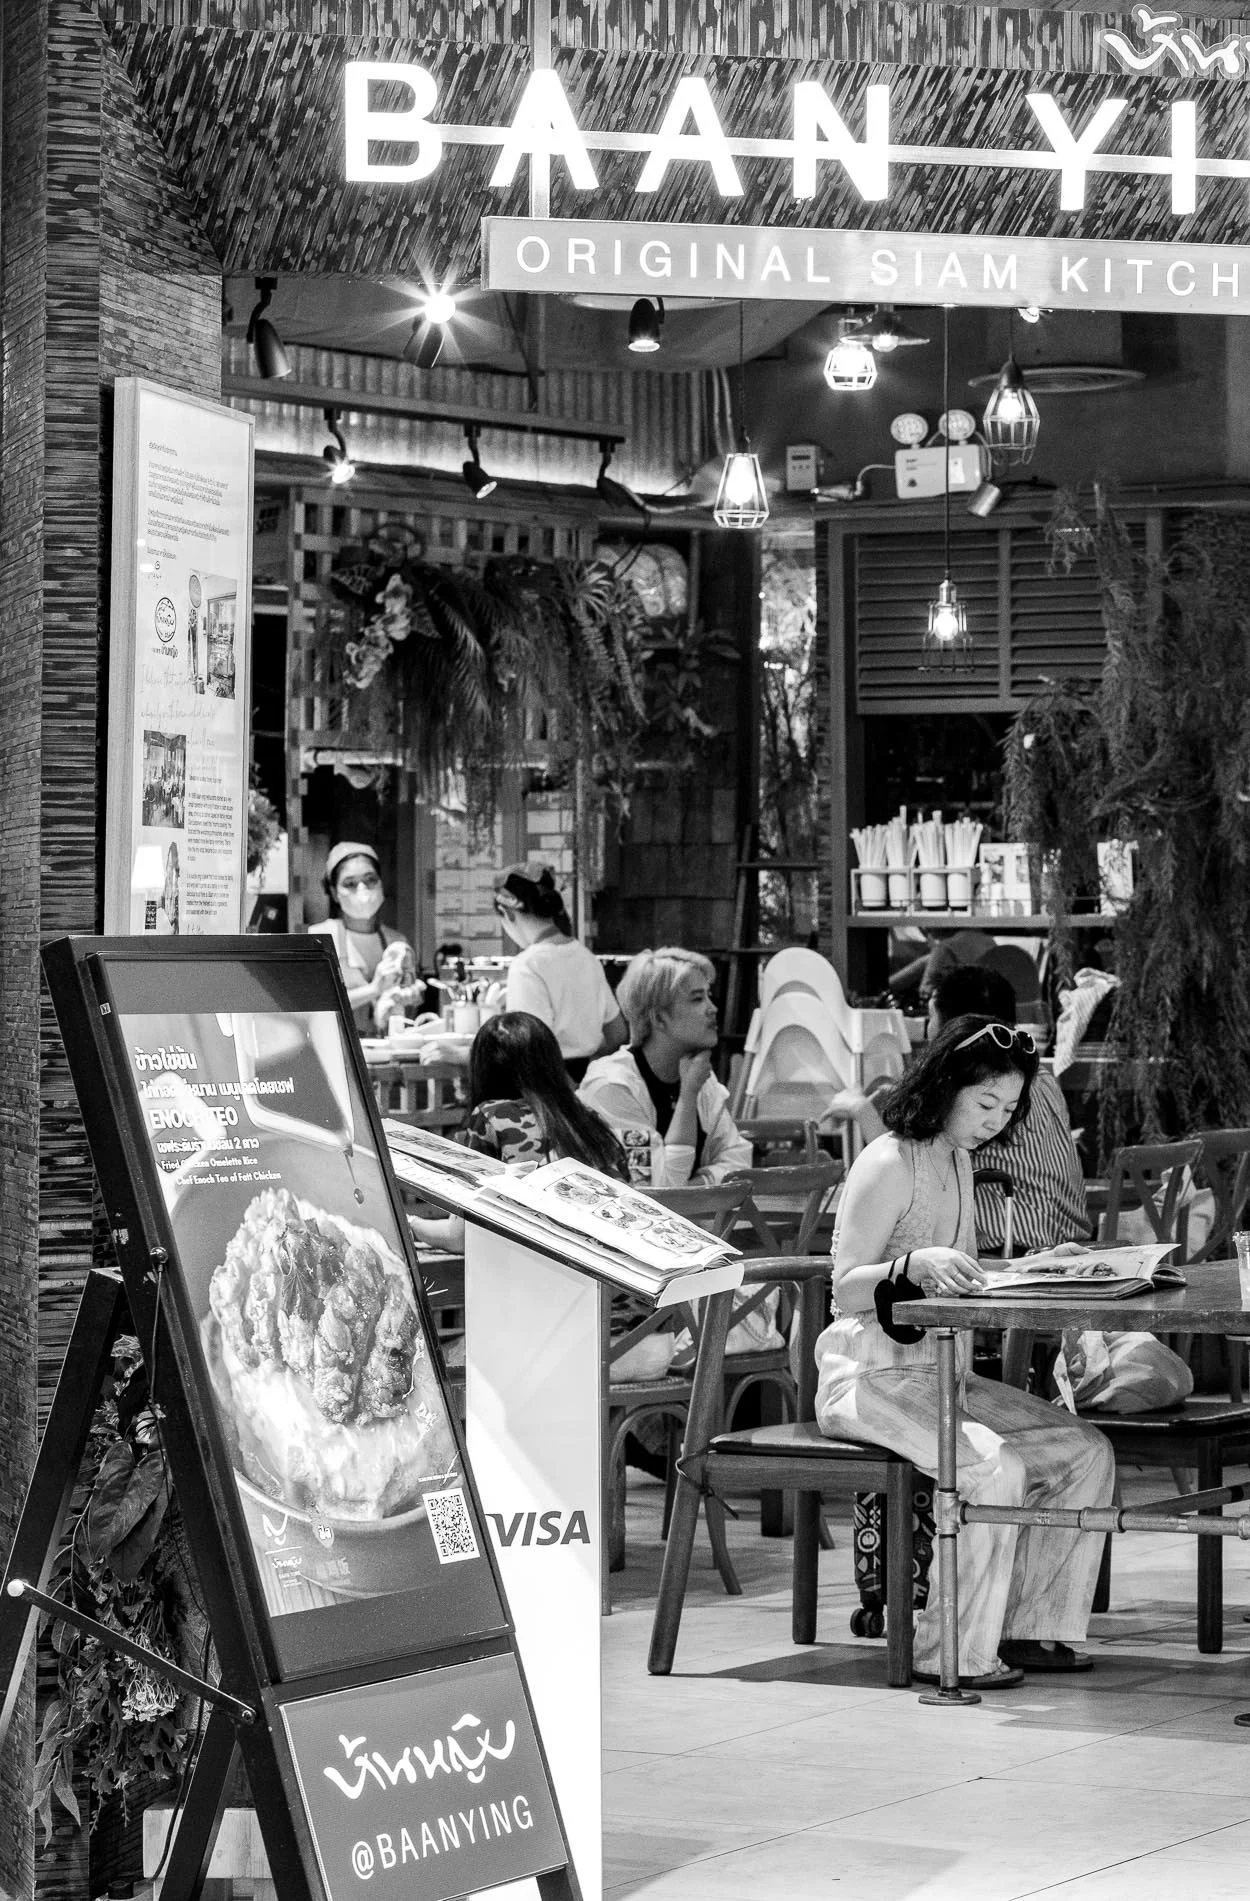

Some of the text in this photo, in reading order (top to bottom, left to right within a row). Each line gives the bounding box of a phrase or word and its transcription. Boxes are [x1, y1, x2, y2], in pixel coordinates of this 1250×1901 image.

[344, 61, 890, 201] BAAN
[516, 235, 831, 284] ORIGINAL
[871, 249, 1017, 290] SIAM
[161, 1159, 180, 1171] Fried
[215, 1173, 229, 1183] Teo
[253, 1168, 281, 1180] Chicken
[485, 1510, 591, 1547] VISA
[351, 1795, 534, 1881] @BAANYING
